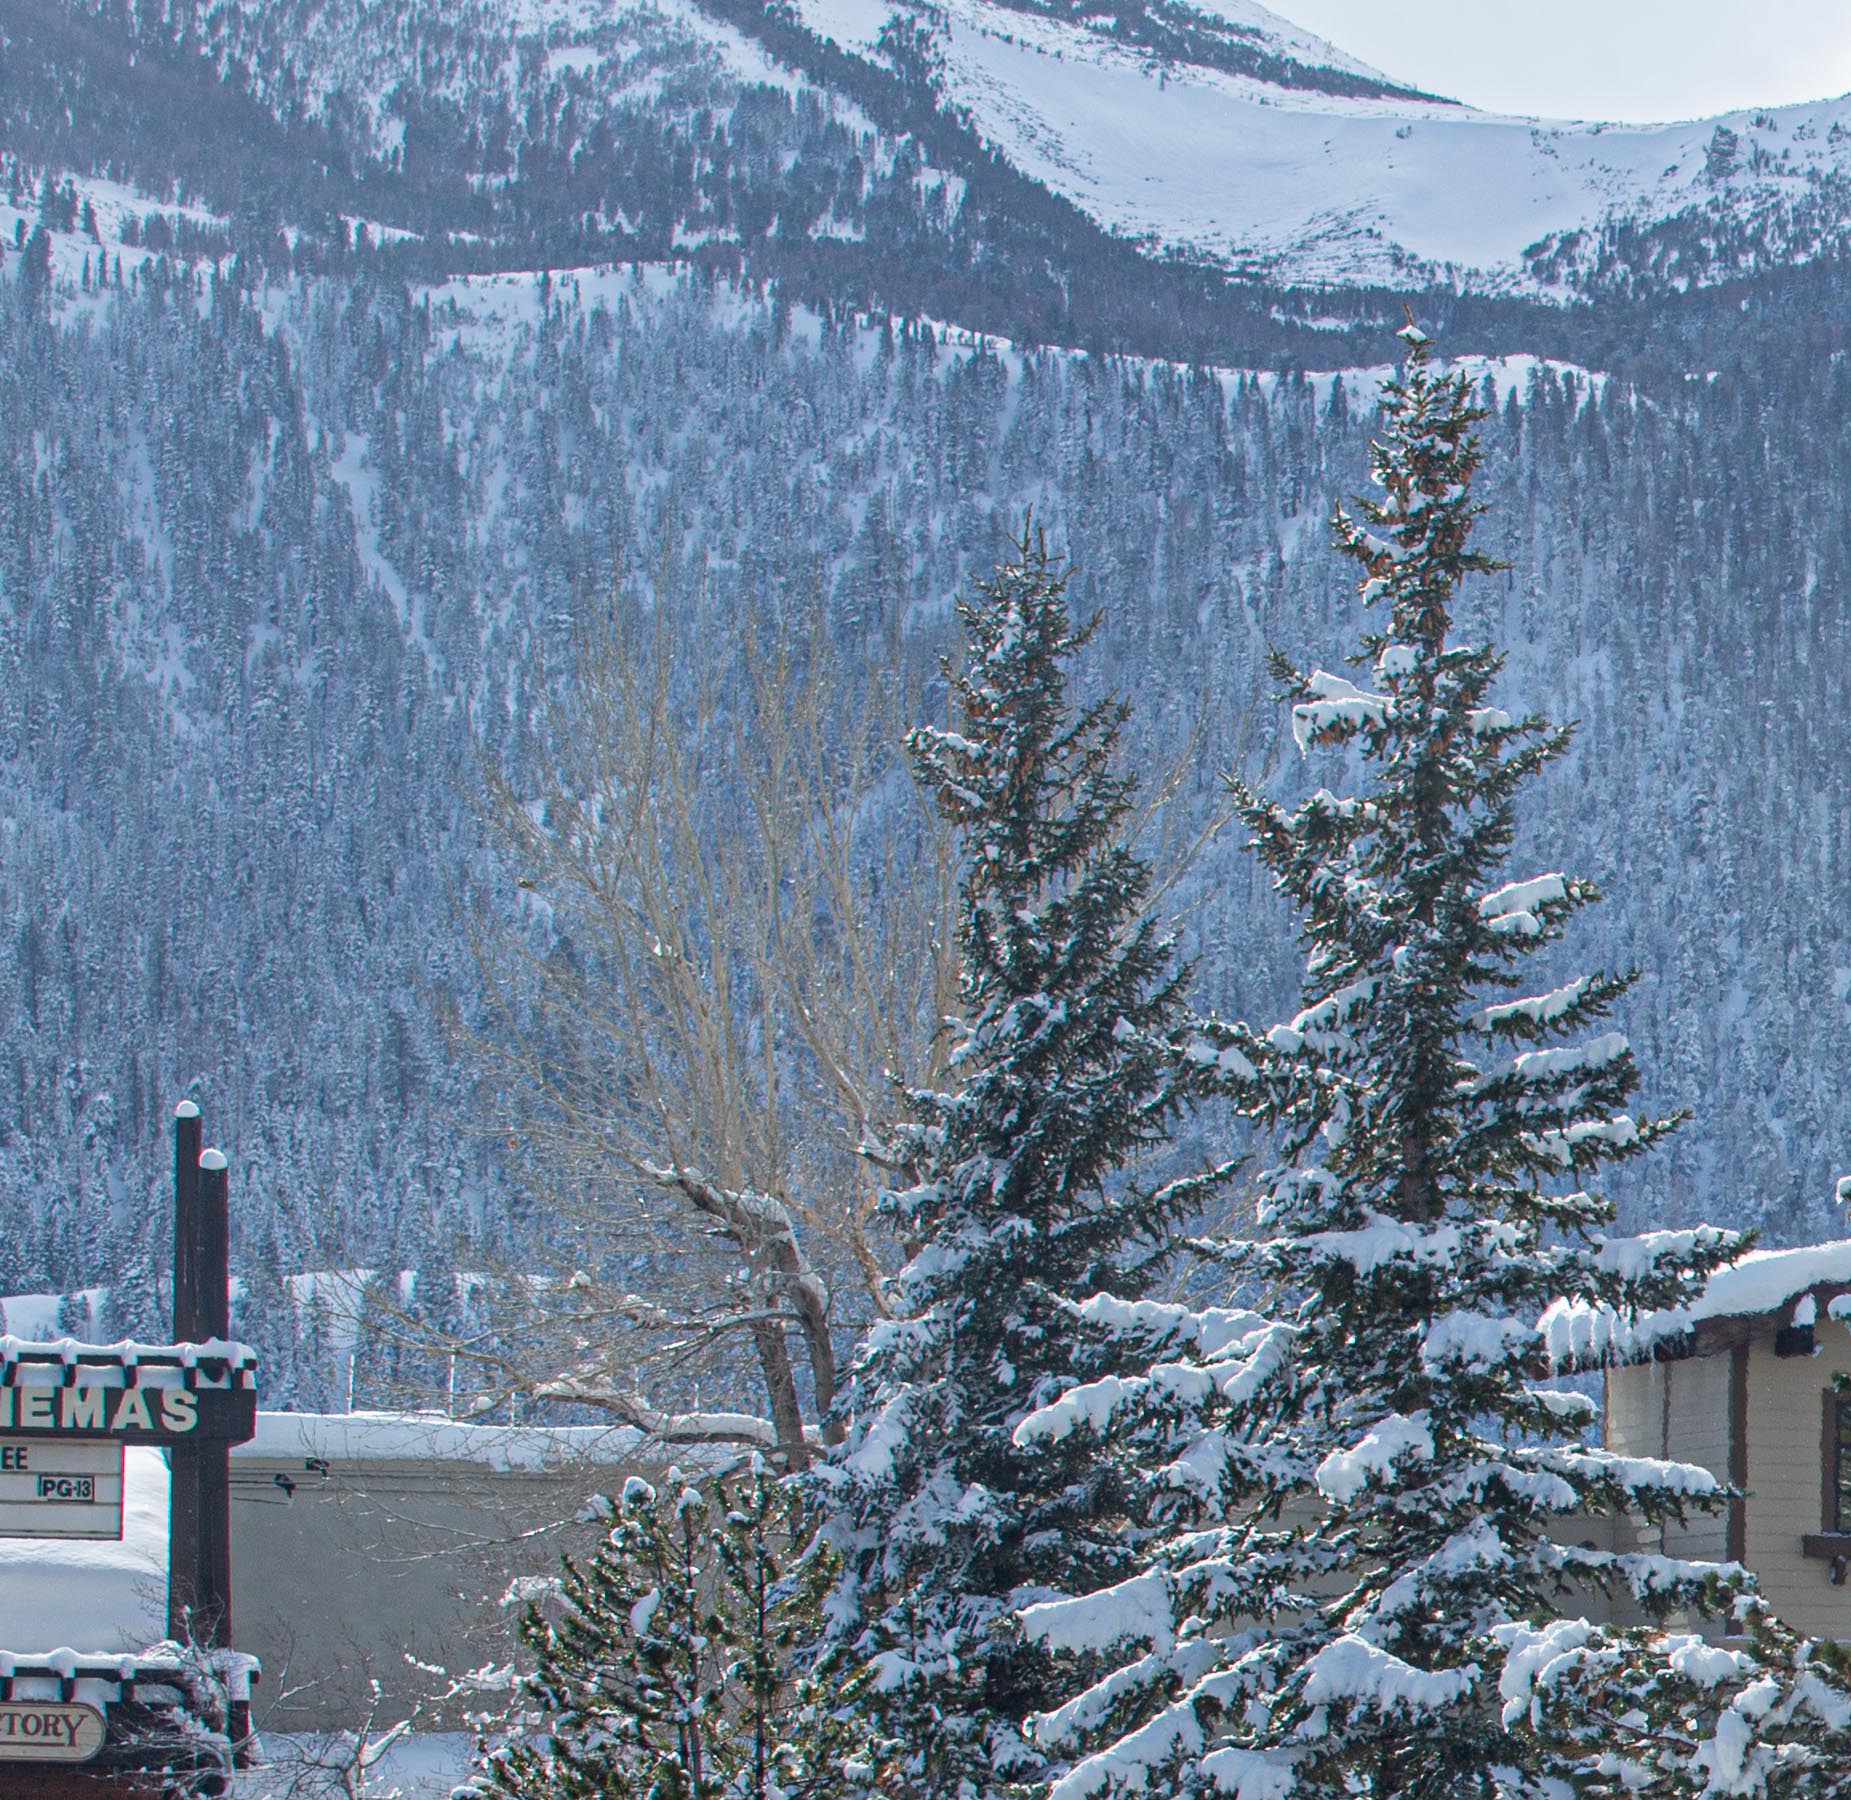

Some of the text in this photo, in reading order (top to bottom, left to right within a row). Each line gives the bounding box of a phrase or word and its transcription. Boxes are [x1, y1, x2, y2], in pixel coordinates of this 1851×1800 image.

[1, 1446, 28, 1470] EE
[42, 1479, 92, 1497] PG-13
[0, 1713, 88, 1747] TORY
